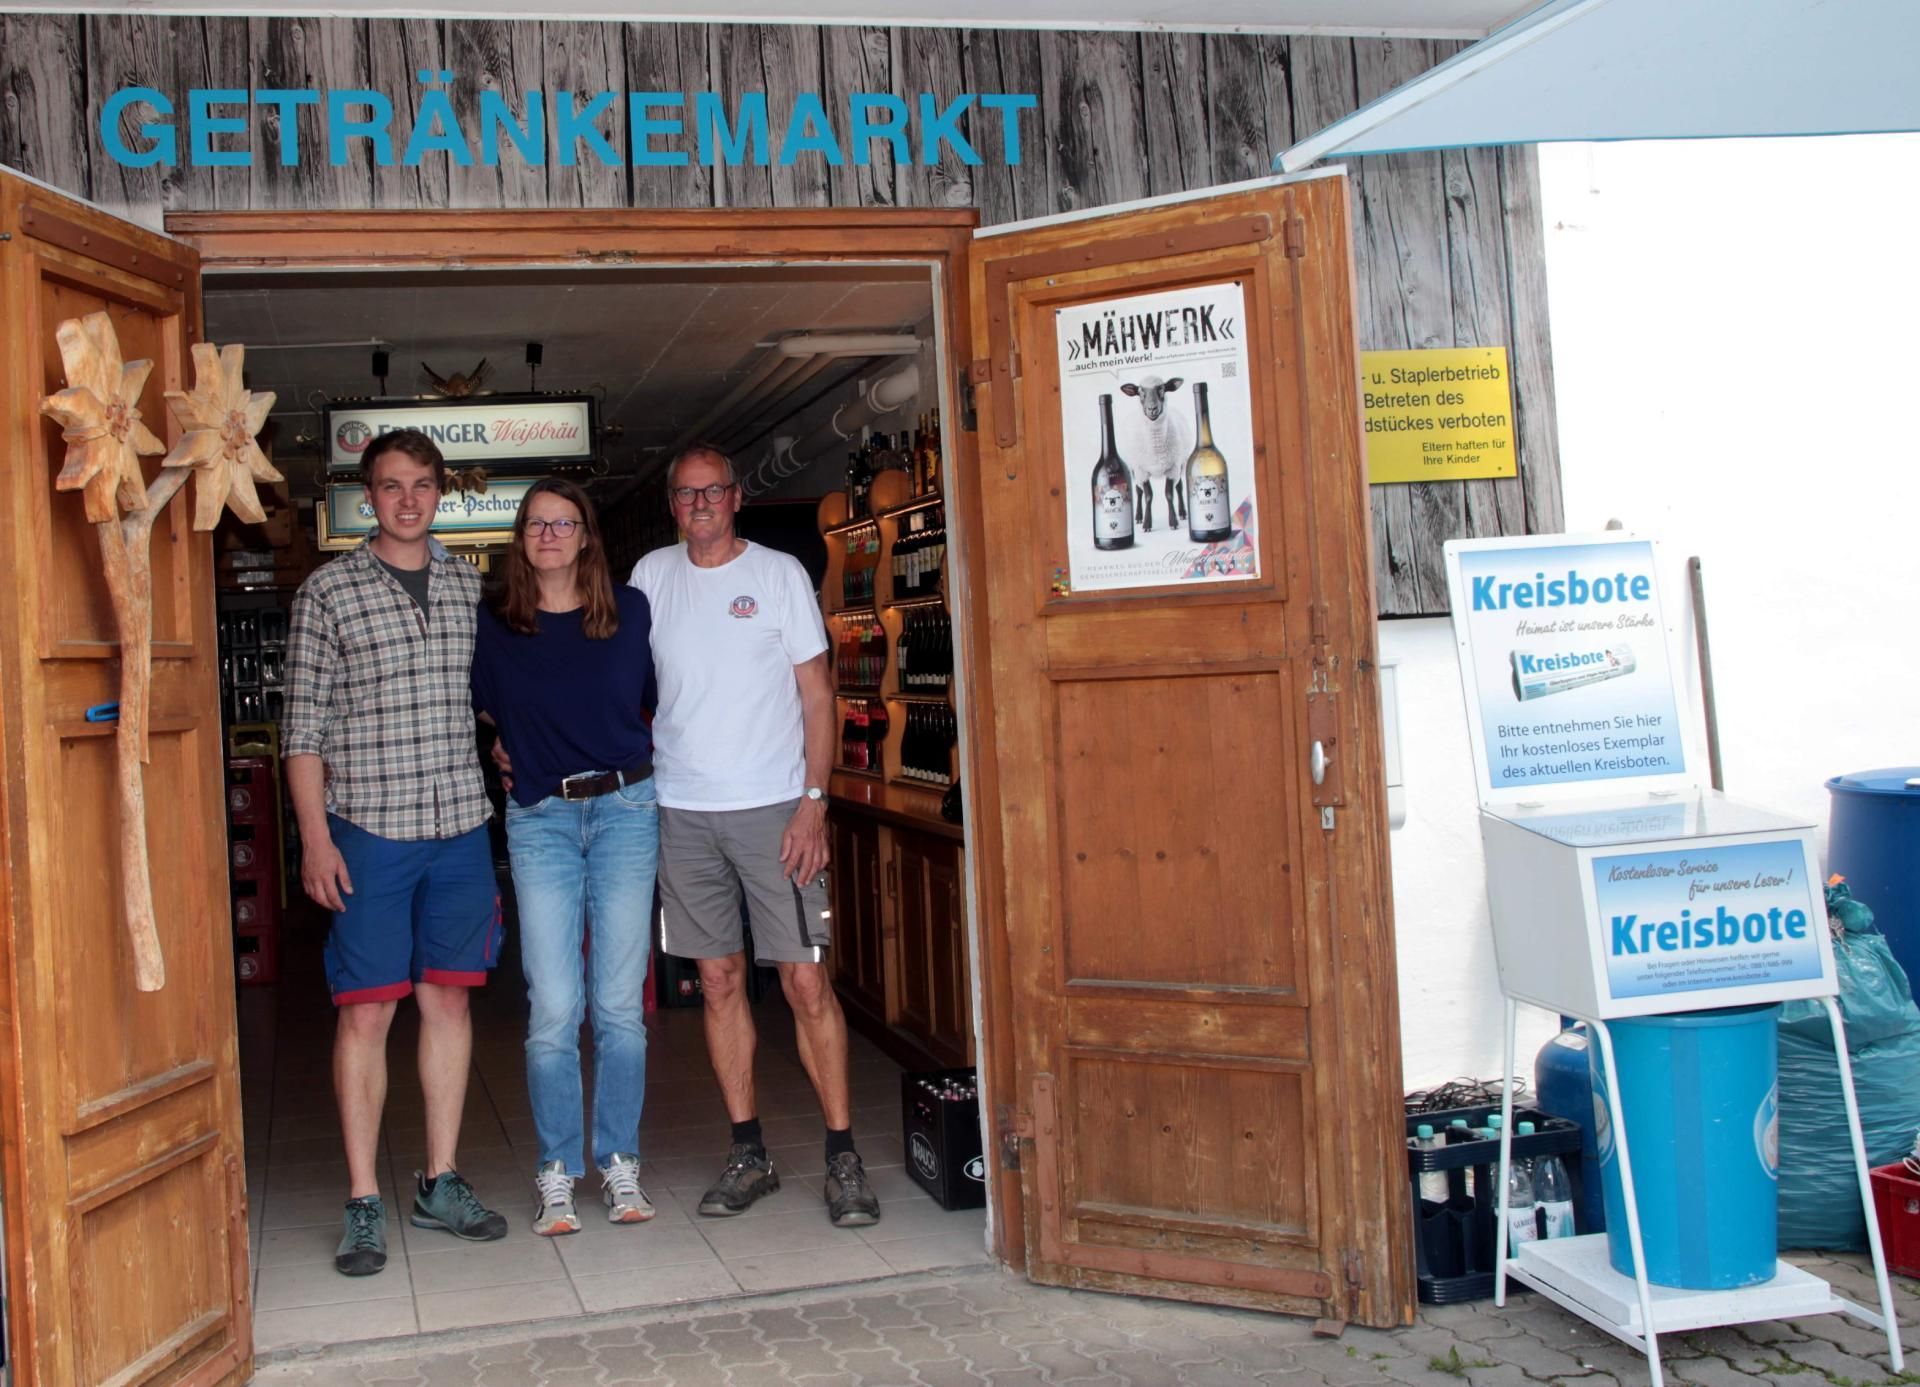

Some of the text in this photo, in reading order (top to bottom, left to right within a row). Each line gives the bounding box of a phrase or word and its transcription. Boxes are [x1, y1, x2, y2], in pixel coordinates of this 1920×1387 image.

[100, 70, 1037, 169] GETRÄNKEMARKT
[1100, 357, 1123, 368] mein
[1124, 352, 1153, 364] Werk!
[1372, 364, 1500, 387] u. Staplerbetrieb
[1364, 390, 1464, 409] Betreten des
[491, 417, 580, 447] Weißbräu
[1438, 413, 1506, 429] verboten
[1422, 439, 1506, 452] Eltern haften für
[1424, 454, 1480, 466] Ihre Kinder
[1472, 570, 1650, 611] Kreisbote
[1516, 613, 1655, 637] Heimat ist unsere Stärke
[1520, 650, 1605, 675] Kreisbote
[1498, 714, 1662, 738] Bitte entnehmen Sie hier
[1501, 734, 1665, 758] Ihr kostenloses Exemplar
[1502, 754, 1670, 778] des aktuellen Kreisboten.
[1608, 859, 1719, 883] Kostenloser Service
[1688, 868, 1793, 901] für unsere Leser!
[1611, 905, 1807, 956] Kreisbote
